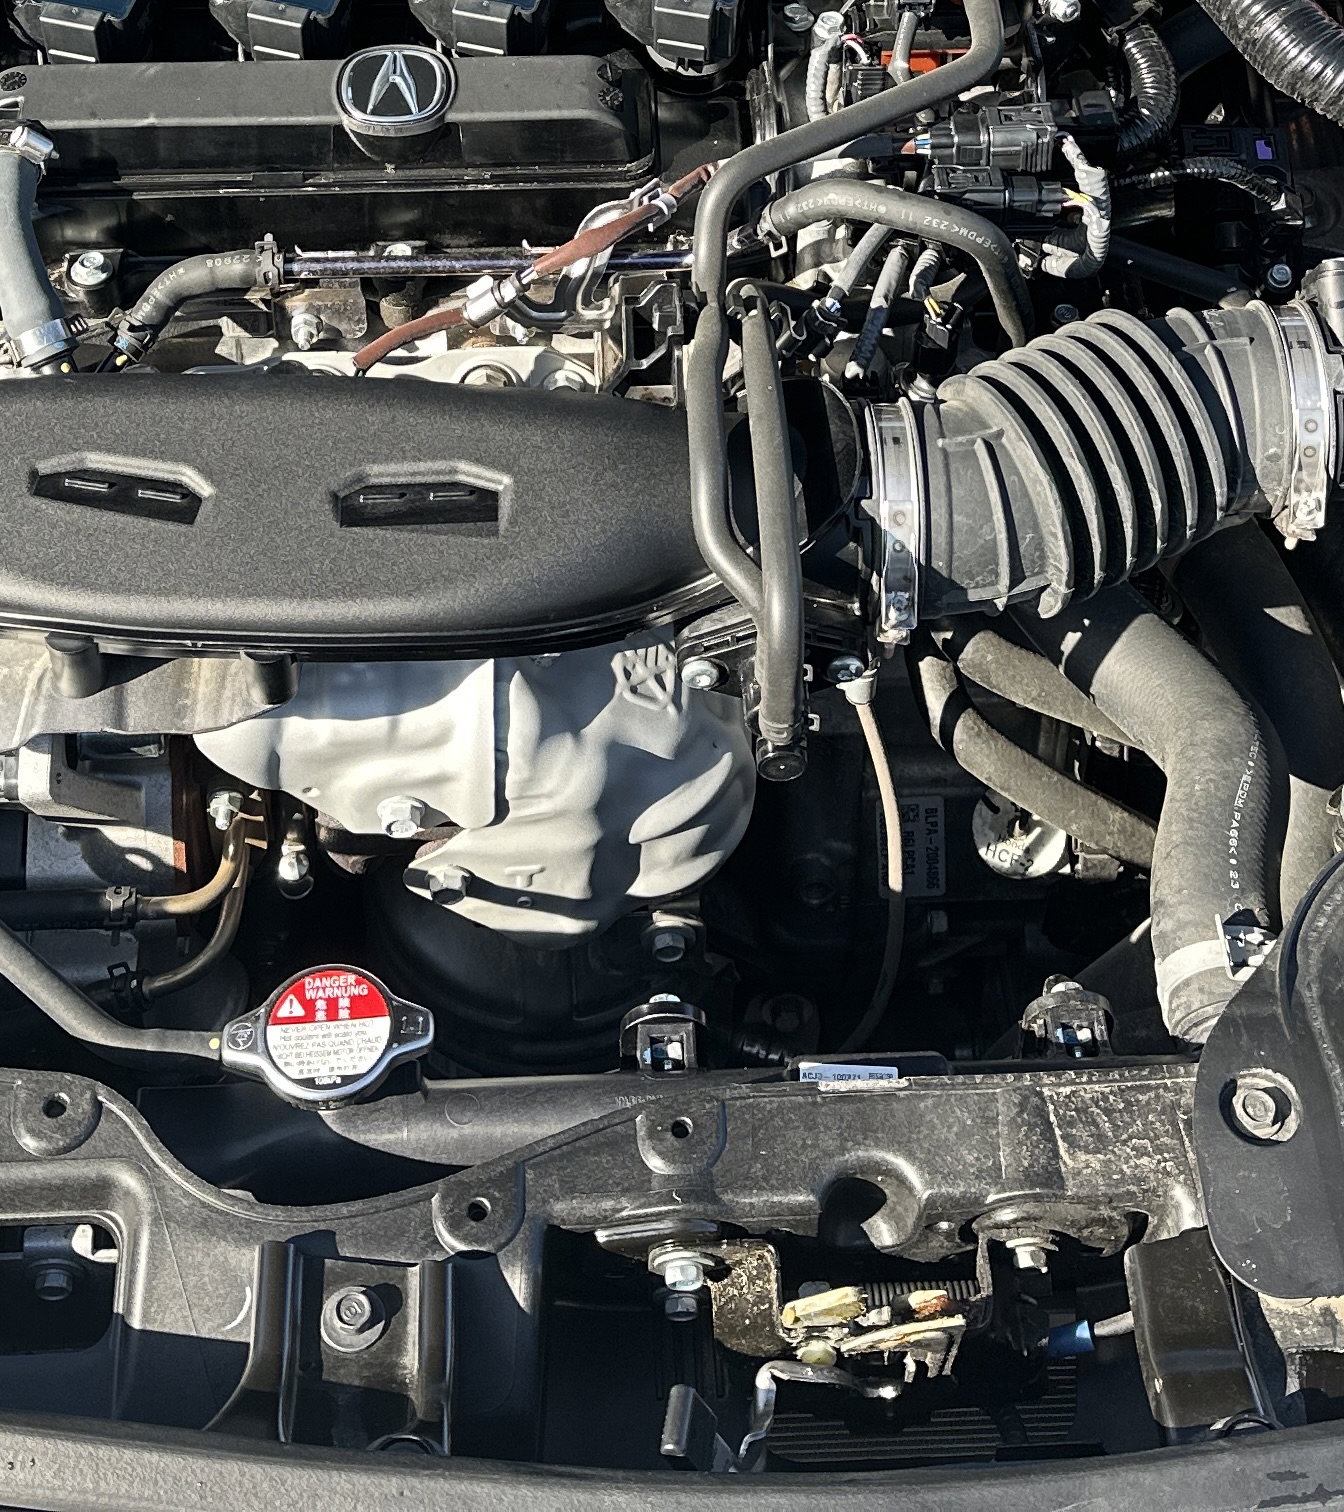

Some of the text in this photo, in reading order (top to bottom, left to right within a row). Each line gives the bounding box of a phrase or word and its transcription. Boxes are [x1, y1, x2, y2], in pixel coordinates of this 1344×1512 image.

[985, 842, 1034, 873] HCF-2
[305, 975, 357, 989] DANGER
[305, 984, 369, 1000] WARNUNG
[309, 1021, 331, 1032] OPEN
